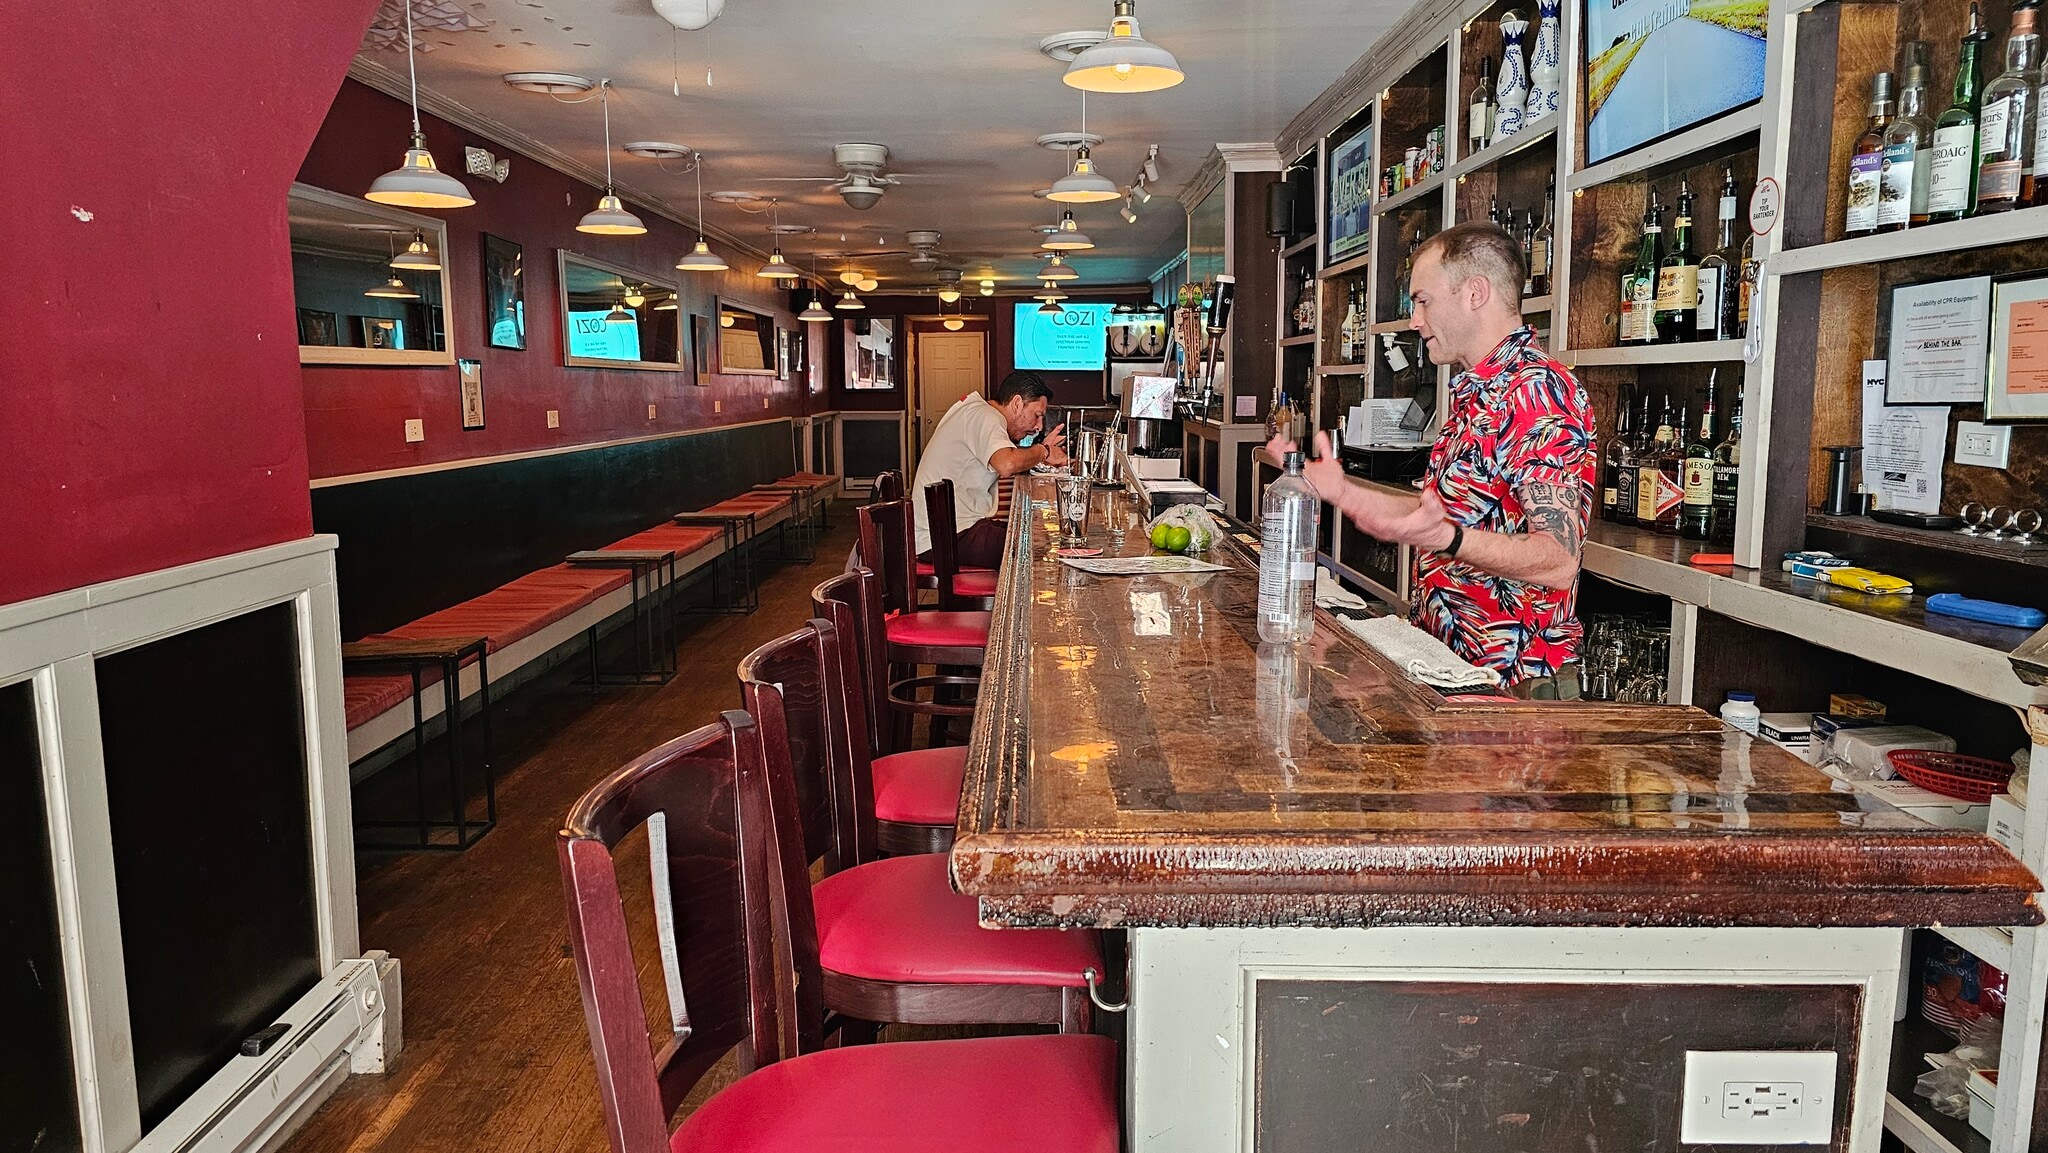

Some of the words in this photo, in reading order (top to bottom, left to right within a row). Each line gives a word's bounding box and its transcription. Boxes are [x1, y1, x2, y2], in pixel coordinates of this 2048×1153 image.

[1753, 210, 1774, 219] BARTENDER
[1954, 295, 1978, 303] Equipment
[1053, 311, 1094, 325] COZI
[1866, 378, 1884, 386] NYC
[1765, 728, 1780, 740] BLACK
